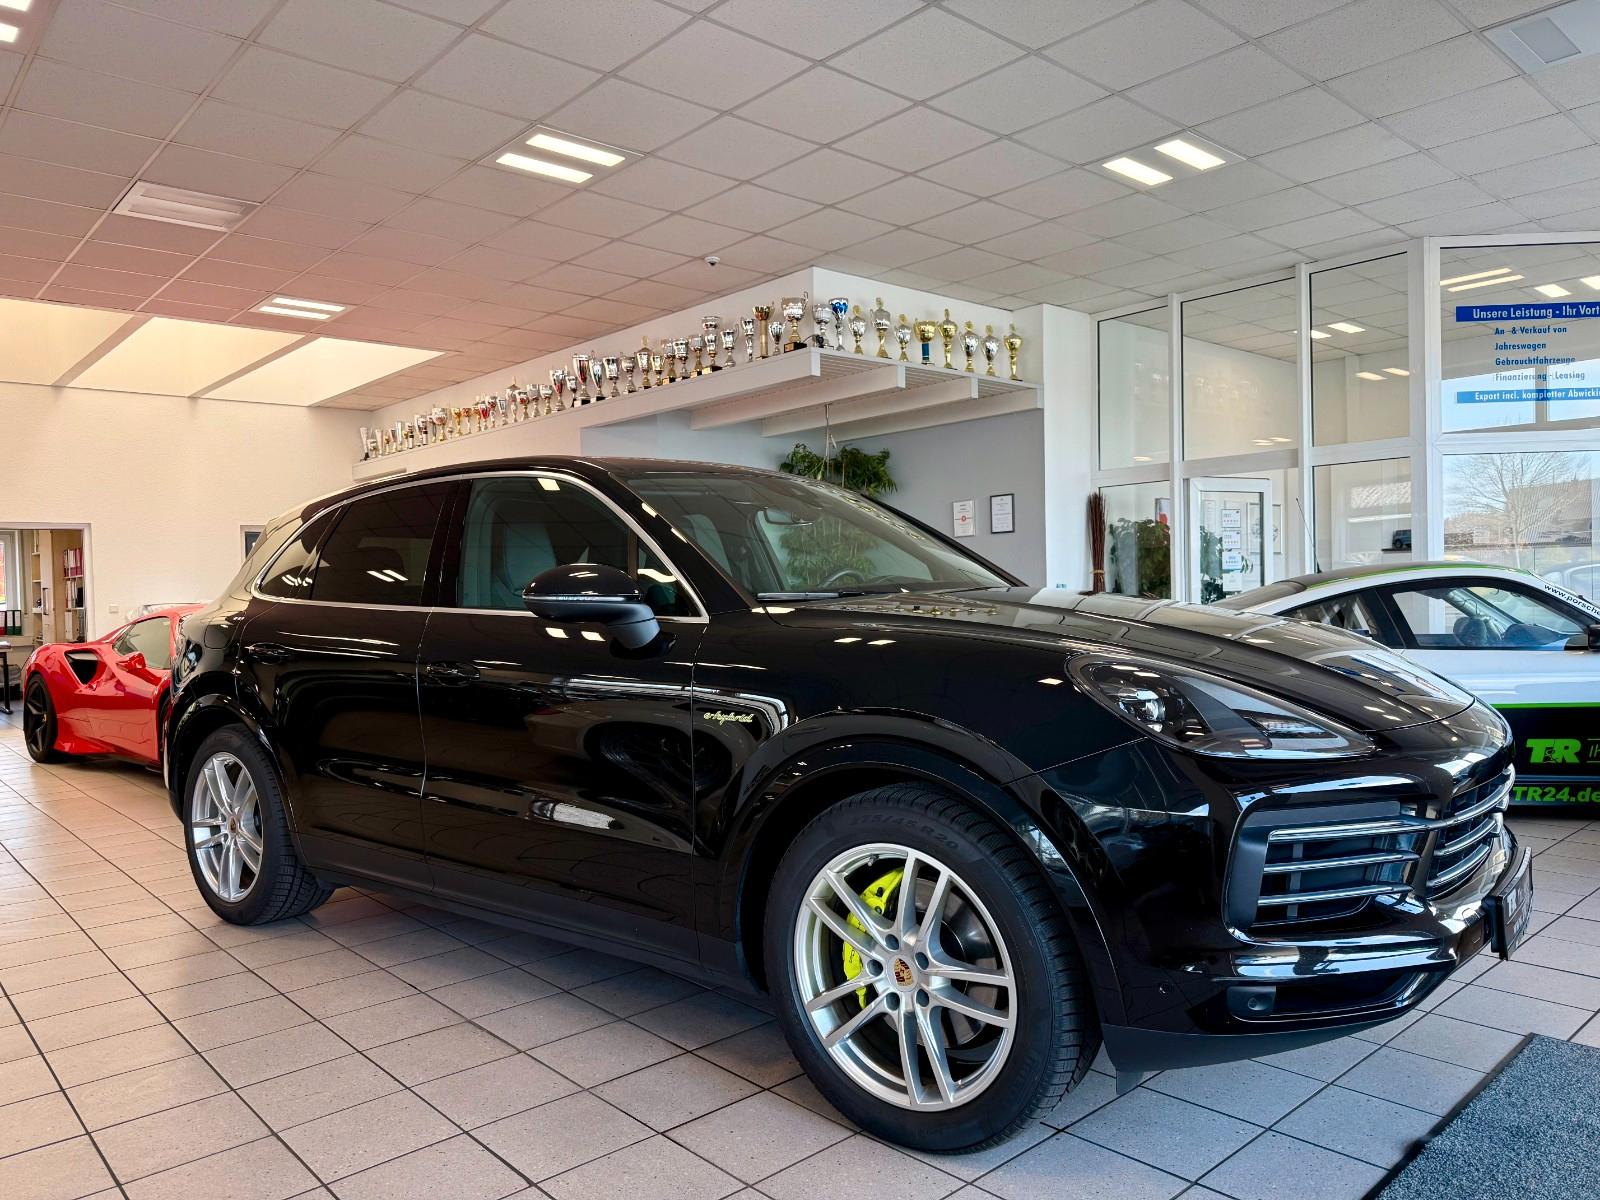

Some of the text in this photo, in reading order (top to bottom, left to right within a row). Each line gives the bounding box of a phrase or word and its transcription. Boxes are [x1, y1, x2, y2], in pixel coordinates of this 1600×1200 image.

[1472, 309, 1508, 319] Unsere
[1510, 307, 1553, 318] Leistung
[1562, 305, 1577, 316] Ihr
[1578, 304, 1600, 315] Vort
[1519, 325, 1551, 334] Verkauf
[1494, 342, 1547, 351] Jahreswagen
[1495, 356, 1576, 366] Gebrauchtfahrzeuge
[1495, 372, 1547, 381] Finanzierung
[1555, 371, 1585, 380] Leasing
[1475, 388, 1600, 401] Export incl. kompletter Abwickl
